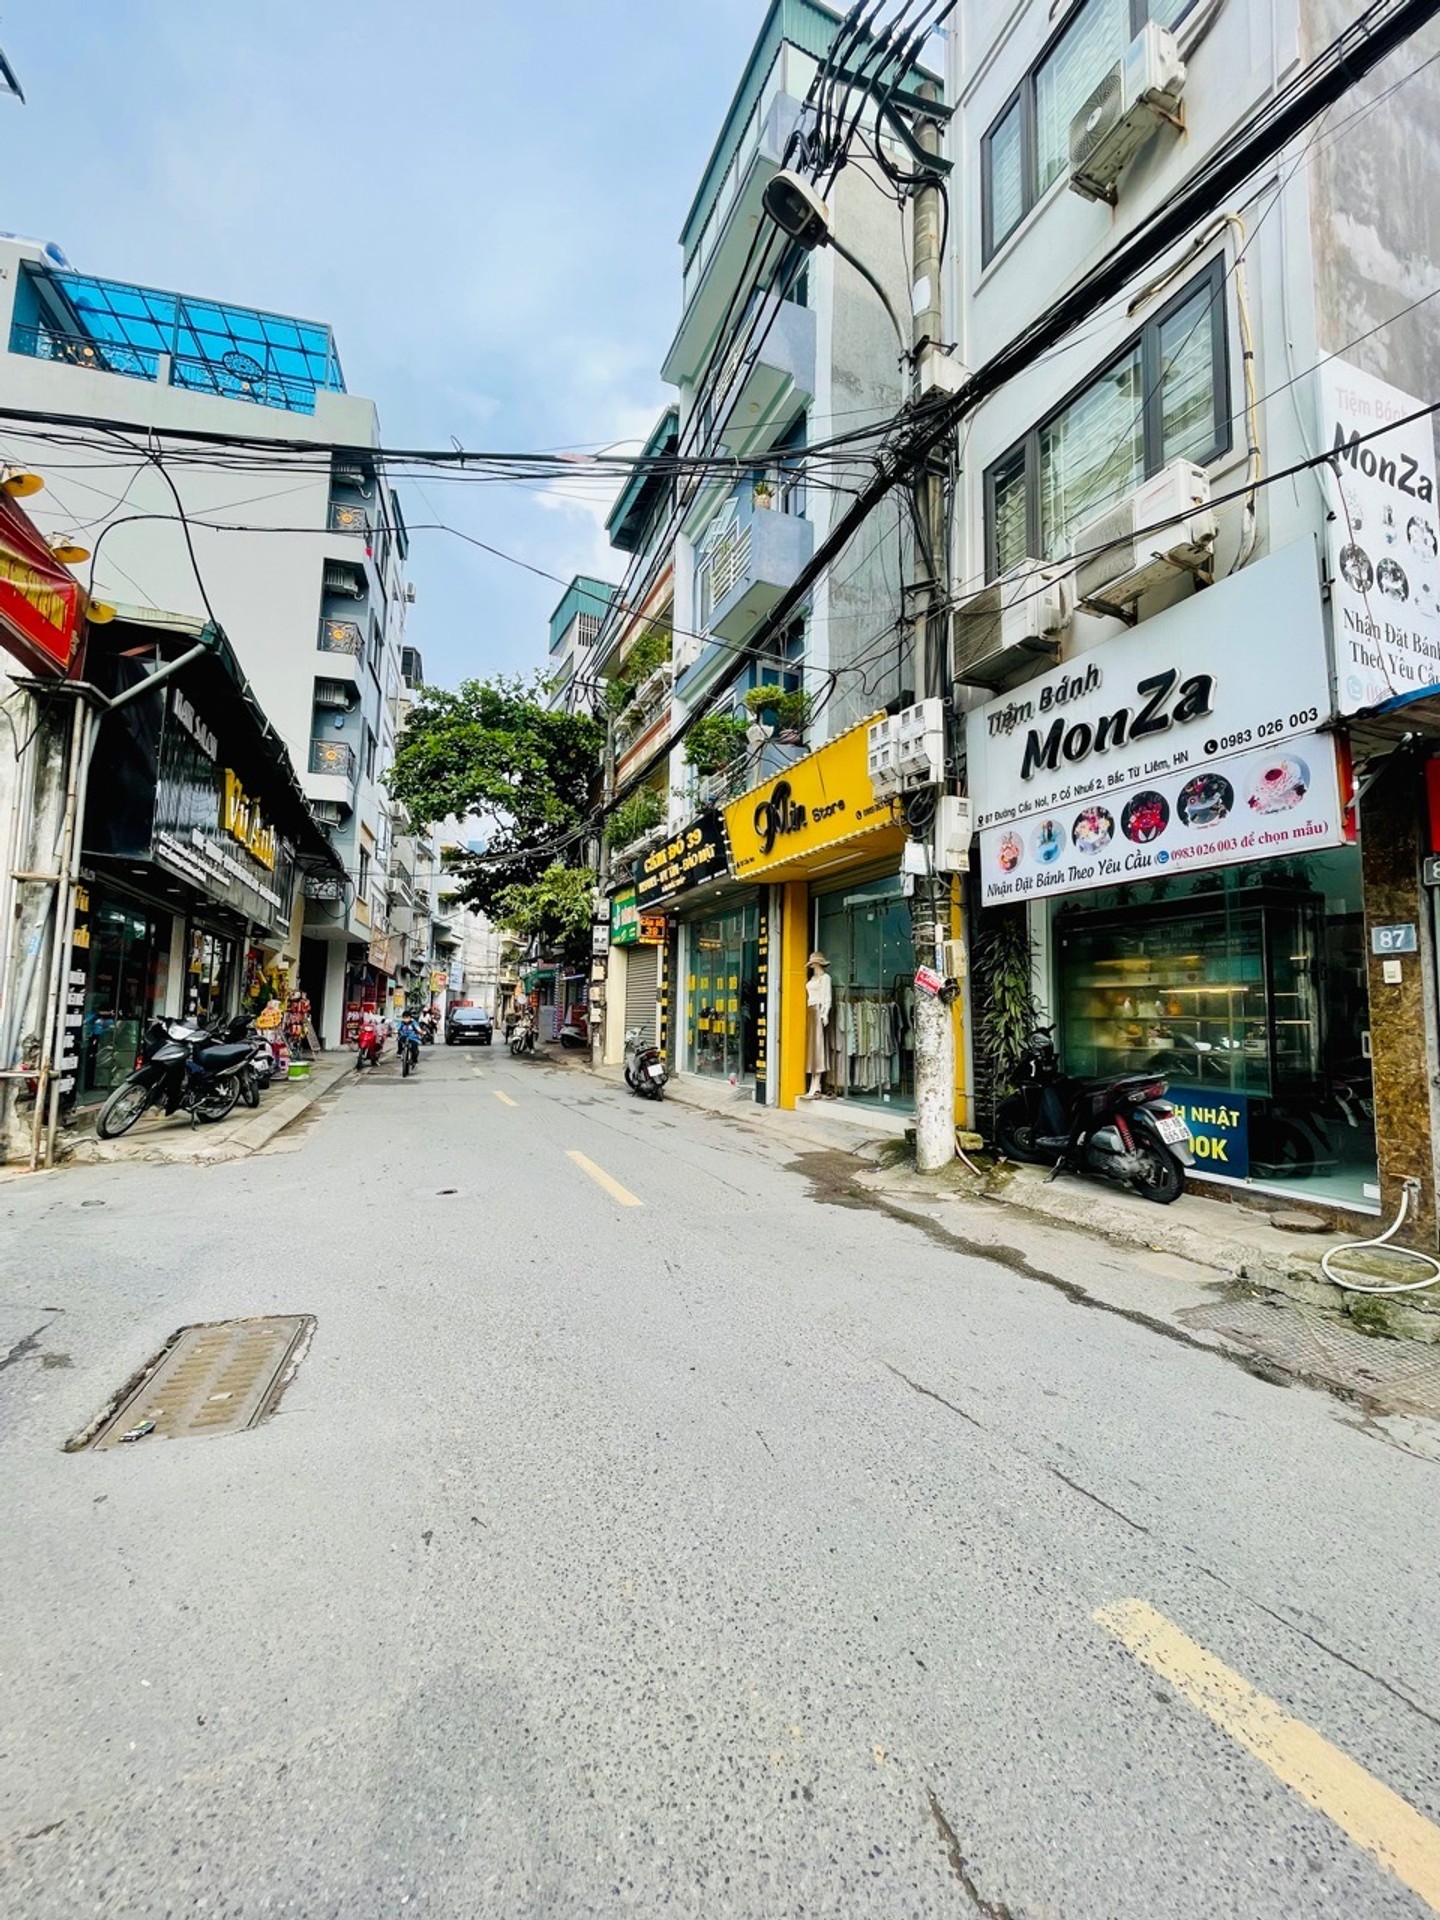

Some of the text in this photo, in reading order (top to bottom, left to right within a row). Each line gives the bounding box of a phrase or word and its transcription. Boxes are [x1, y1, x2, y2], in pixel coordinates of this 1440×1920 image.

[1333, 421, 1434, 504] MonZa
[1344, 607, 1381, 642] Nhận
[1384, 621, 1409, 653] Đặt
[1349, 641, 1384, 670] Theo
[1387, 652, 1414, 680] Yêu
[1040, 663, 1103, 713] Bánh
[1020, 667, 1217, 780] MonZa
[1220, 707, 1319, 750] 0983 026 003
[1107, 769, 1125, 786] Bắc
[1173, 750, 1189, 764] HN
[812, 800, 846, 823] Store
[686, 828, 702, 849] 39
[987, 879, 1013, 898] Nhận
[1015, 876, 1033, 893] Đặt
[1036, 870, 1065, 888] Bánh
[1068, 864, 1095, 882] Theo
[1098, 858, 1122, 875] Yêu
[1124, 849, 1152, 871] Cầu
[1197, 844, 1216, 857] 026
[1218, 839, 1238, 852] 003
[1258, 830, 1289, 847] chọn
[1380, 930, 1406, 948] 87
[1191, 1105, 1240, 1131] NHẬT
